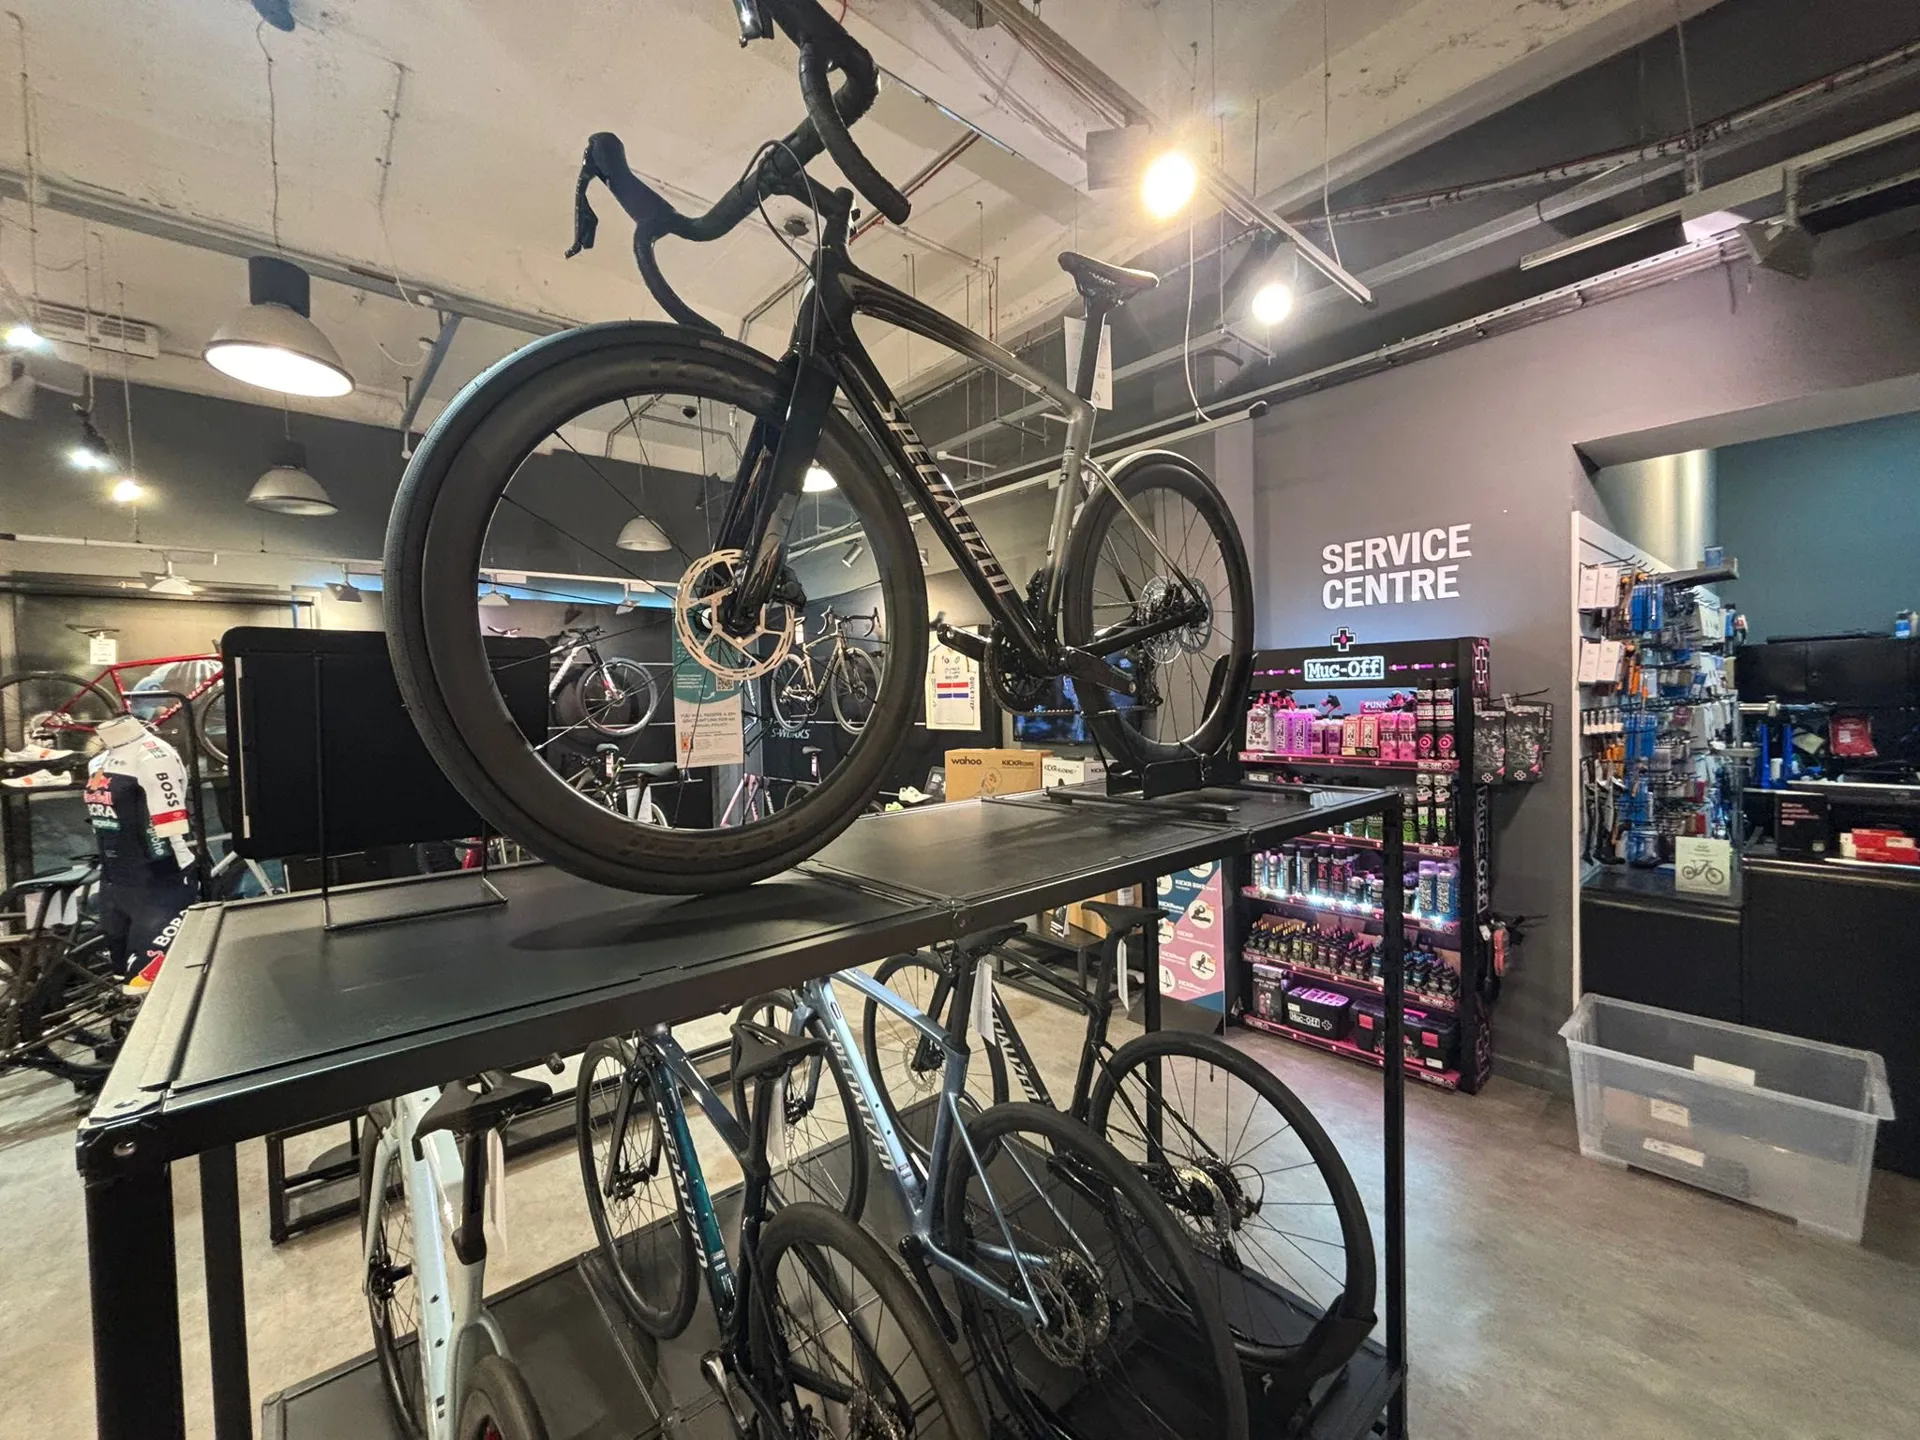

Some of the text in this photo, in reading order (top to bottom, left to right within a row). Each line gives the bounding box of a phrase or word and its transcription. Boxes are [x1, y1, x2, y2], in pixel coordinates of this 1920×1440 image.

[873, 400, 1014, 594] SPECIALIZED
[1322, 523, 1472, 575] SERVICE
[1322, 564, 1460, 610] CENTRE
[1308, 657, 1382, 680] Muc-Off
[951, 756, 982, 766] wahoo
[156, 772, 180, 807] BOSS
[1289, 1011, 1320, 1028] Muc-Off
